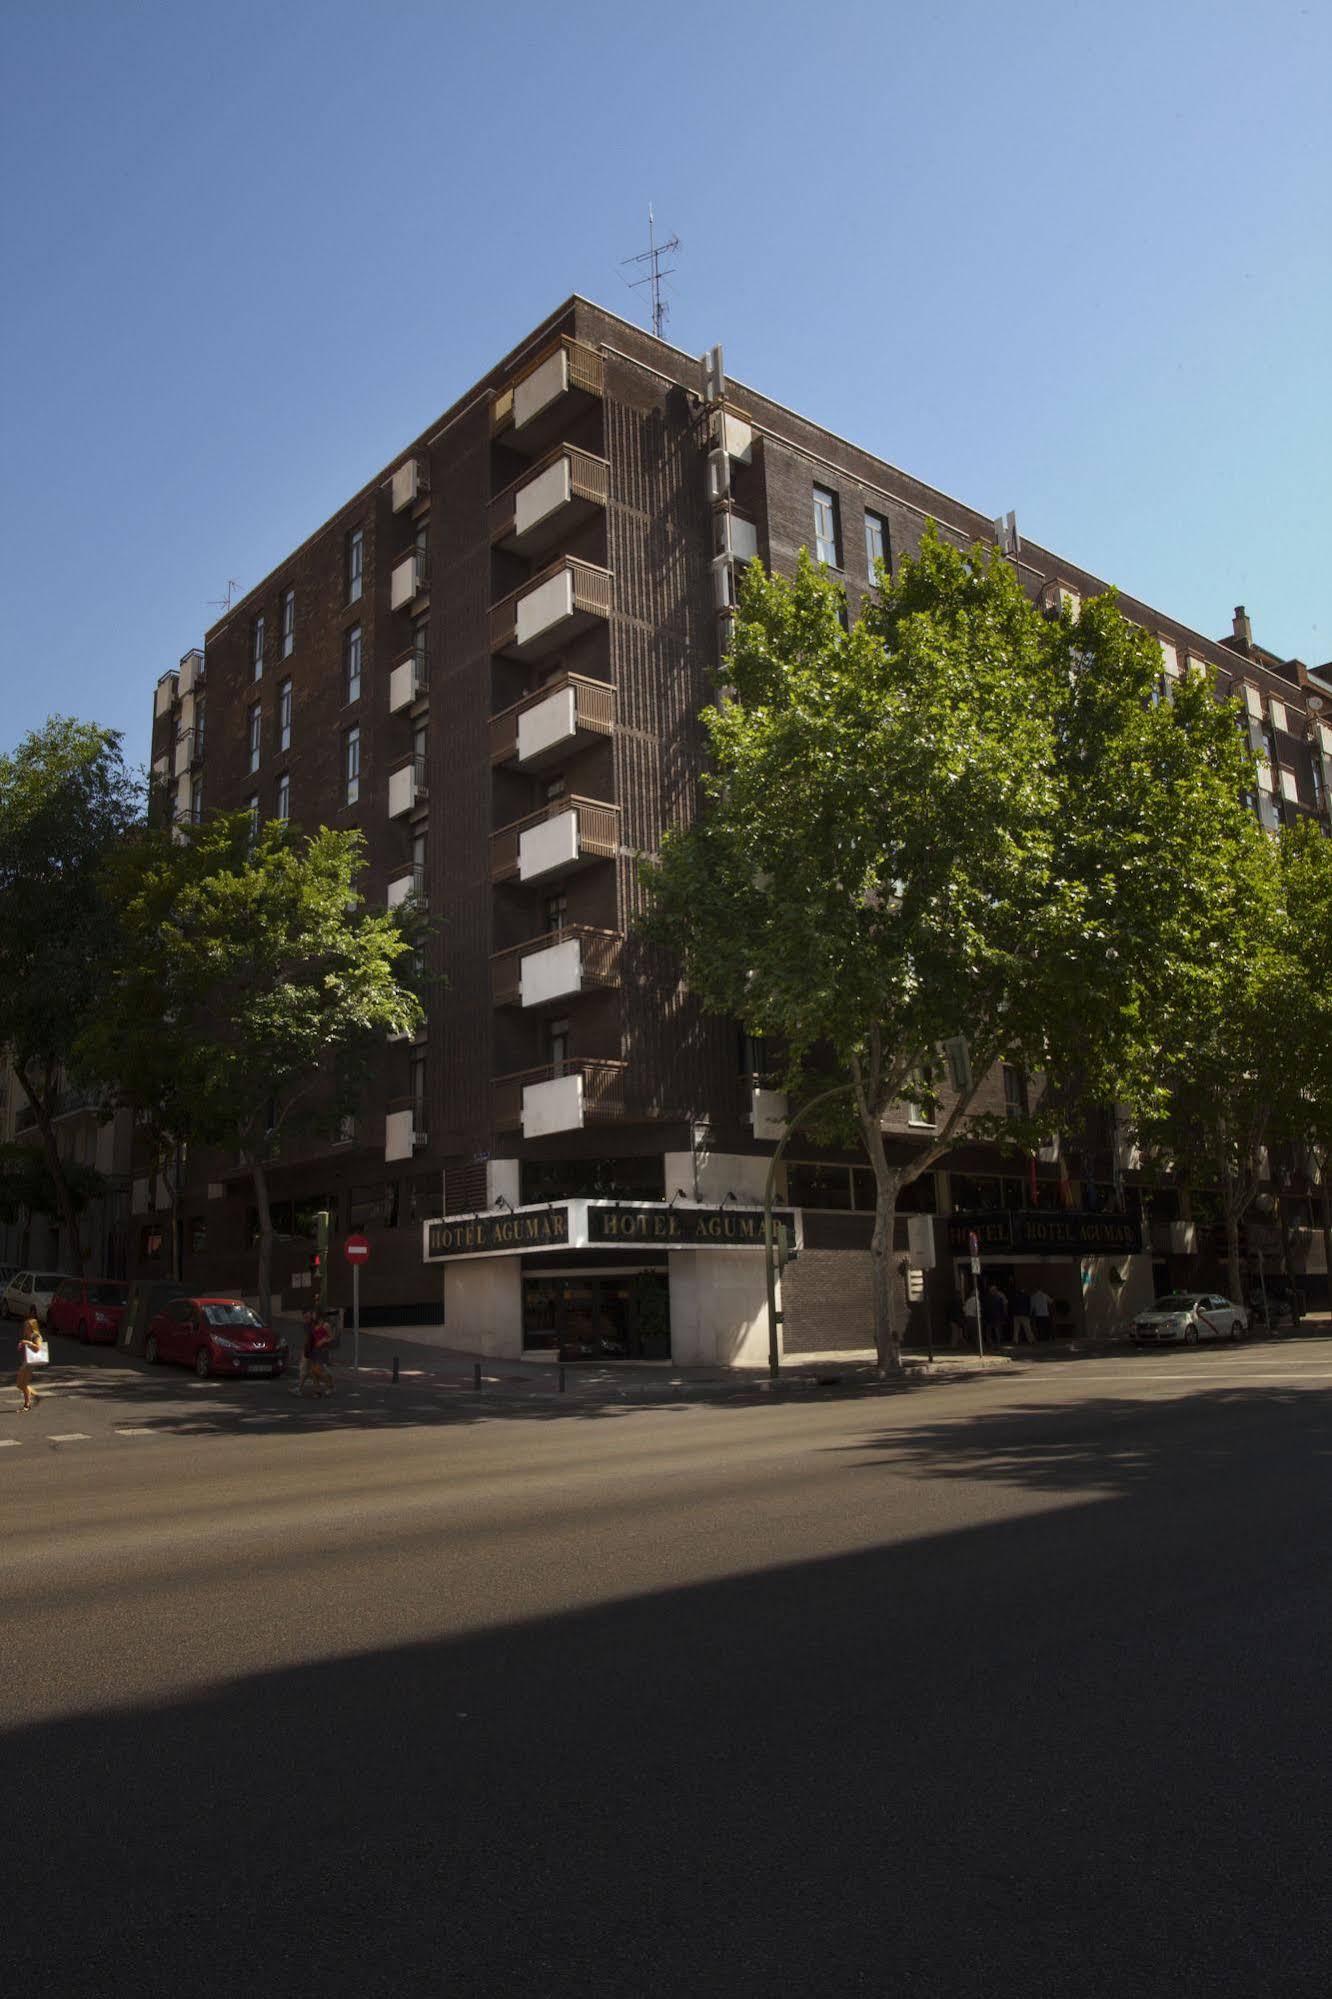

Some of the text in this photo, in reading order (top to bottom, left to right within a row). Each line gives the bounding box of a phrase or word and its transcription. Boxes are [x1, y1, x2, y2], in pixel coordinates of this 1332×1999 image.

[431, 1215, 565, 1249] HOTEL AGUMAR
[602, 1213, 783, 1237] HOTEL AGUMAR
[1024, 1221, 1072, 1241] HOTEL
